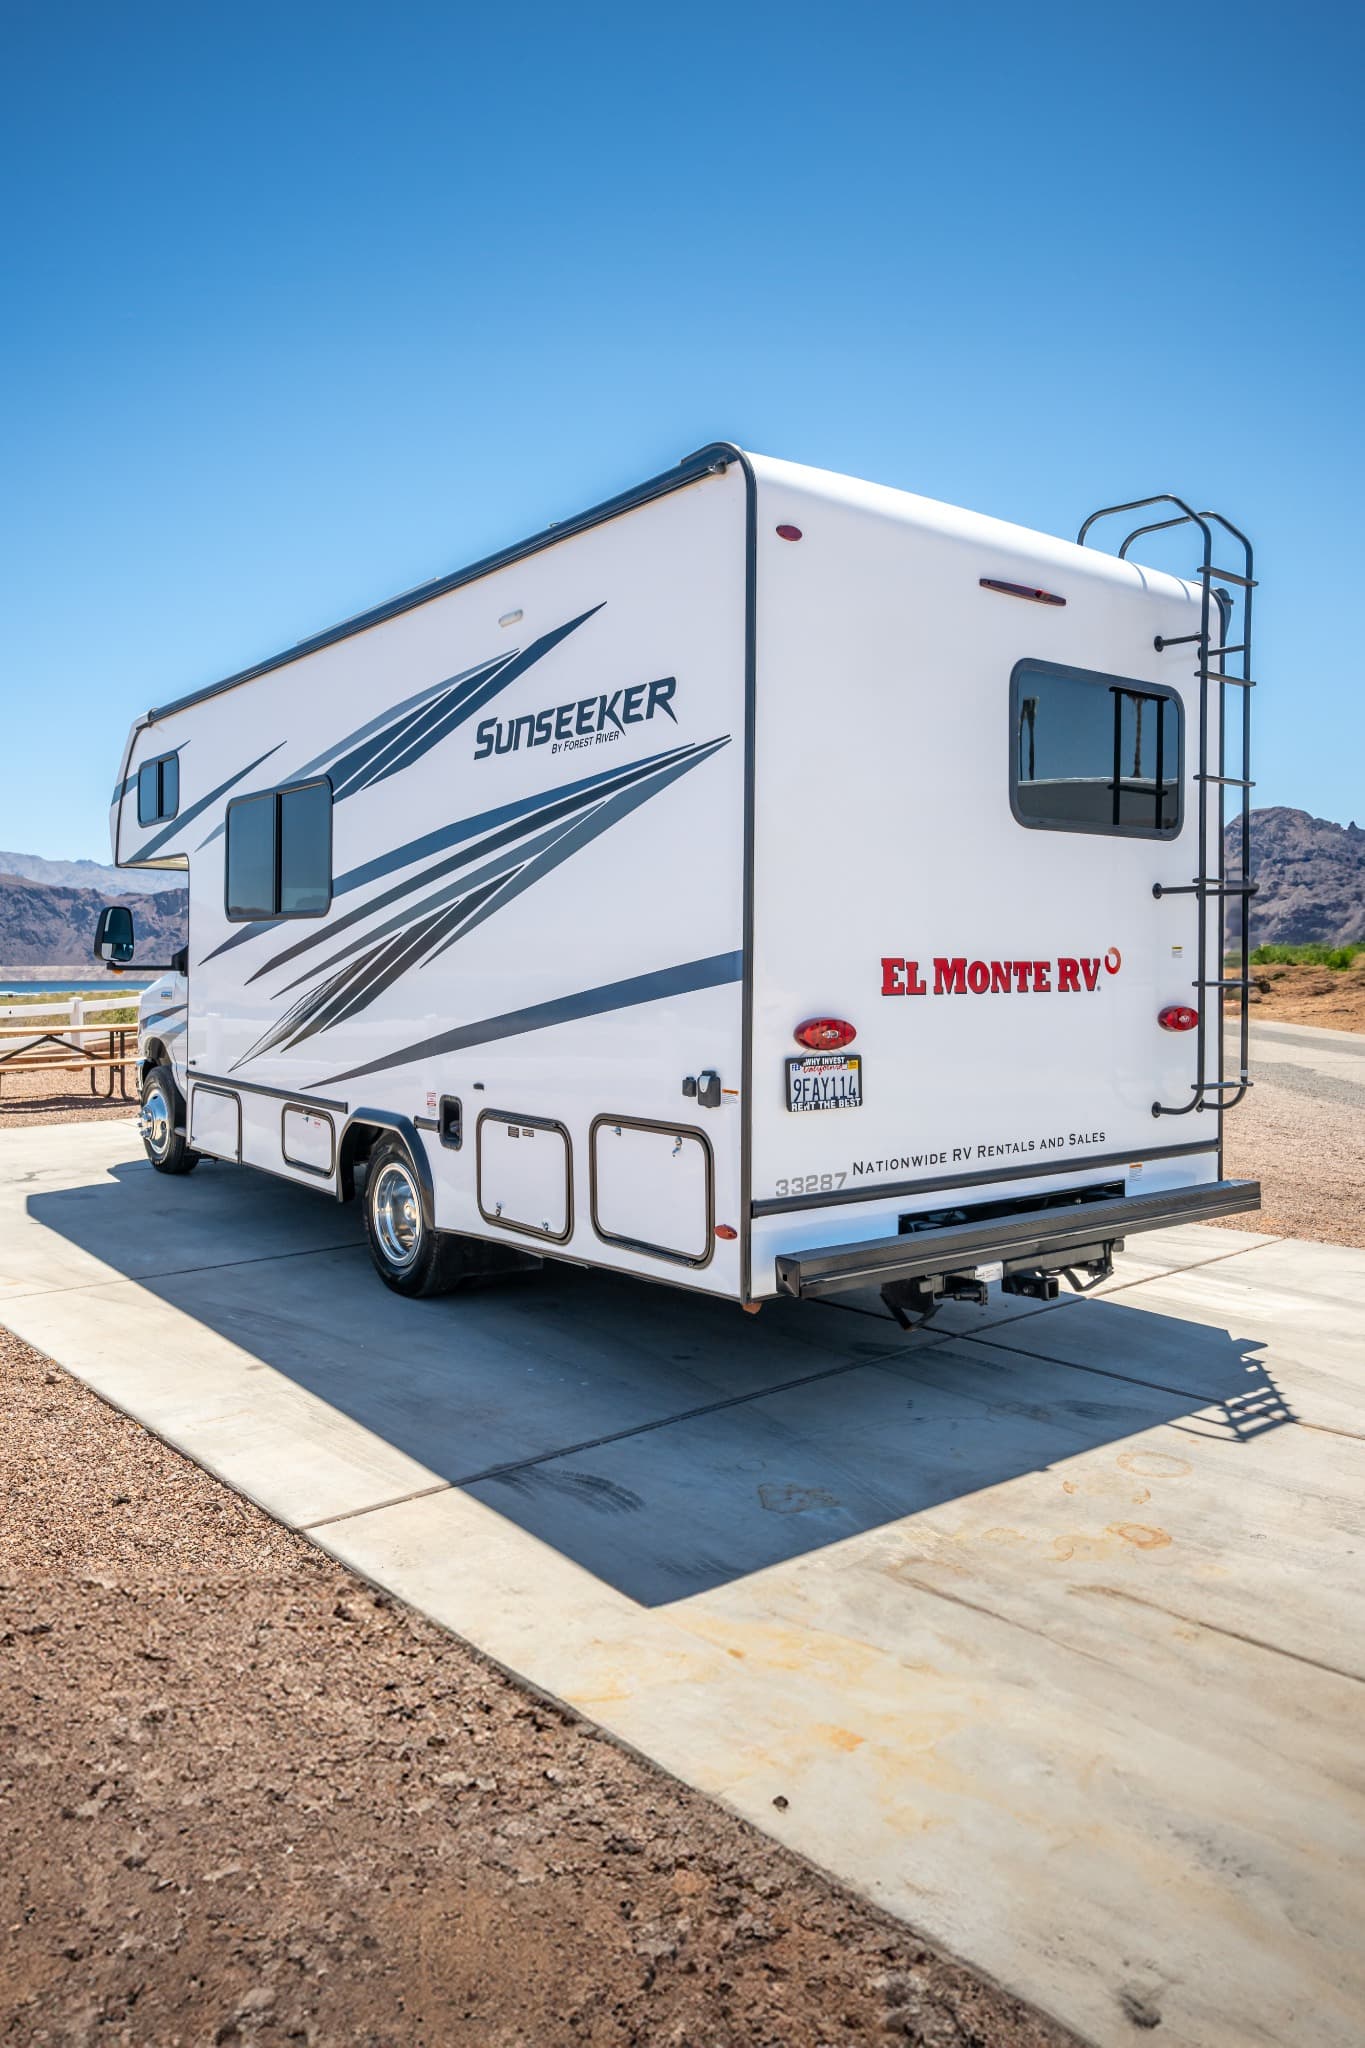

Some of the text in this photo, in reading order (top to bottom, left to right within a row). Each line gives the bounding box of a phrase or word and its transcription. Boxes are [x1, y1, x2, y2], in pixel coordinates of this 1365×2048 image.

[474, 676, 678, 760] SUNSEEKER
[551, 730, 620, 754] BY FOREST RIVER
[881, 957, 1101, 996] EL MONTE RV
[805, 1056, 845, 1066] WHY INVEST
[793, 1075, 857, 1103] 9FAY114
[791, 1097, 861, 1112] RENT THE BEST
[852, 1131, 1107, 1176] NATIONWIDE RV RENTALS AND SALES
[775, 1171, 848, 1198] 33287
